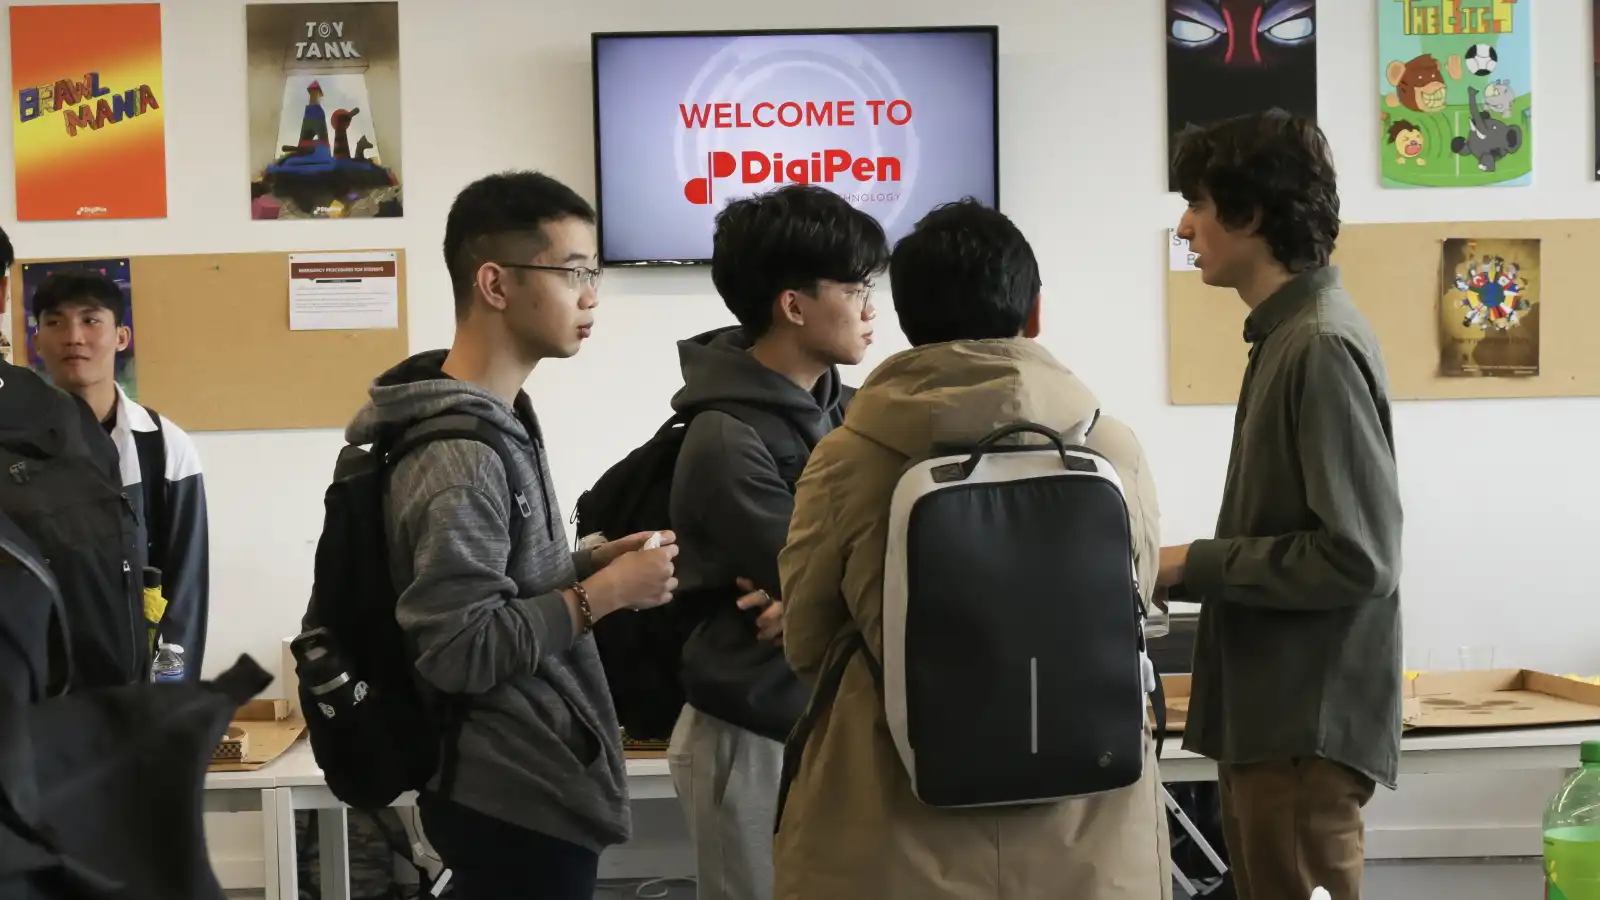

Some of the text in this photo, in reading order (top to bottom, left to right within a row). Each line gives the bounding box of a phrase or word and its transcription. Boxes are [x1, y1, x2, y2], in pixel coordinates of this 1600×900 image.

[305, 21, 344, 38] TOY
[1394, 0, 1439, 35] THE
[1441, 0, 1491, 34] BIG
[295, 41, 361, 59] TANK
[19, 72, 110, 122] BRAWL
[63, 84, 159, 137] MANIA
[679, 99, 913, 129] WELCOME TO
[741, 148, 901, 185] DigiPen
[842, 192, 901, 203] HNOLOGY
